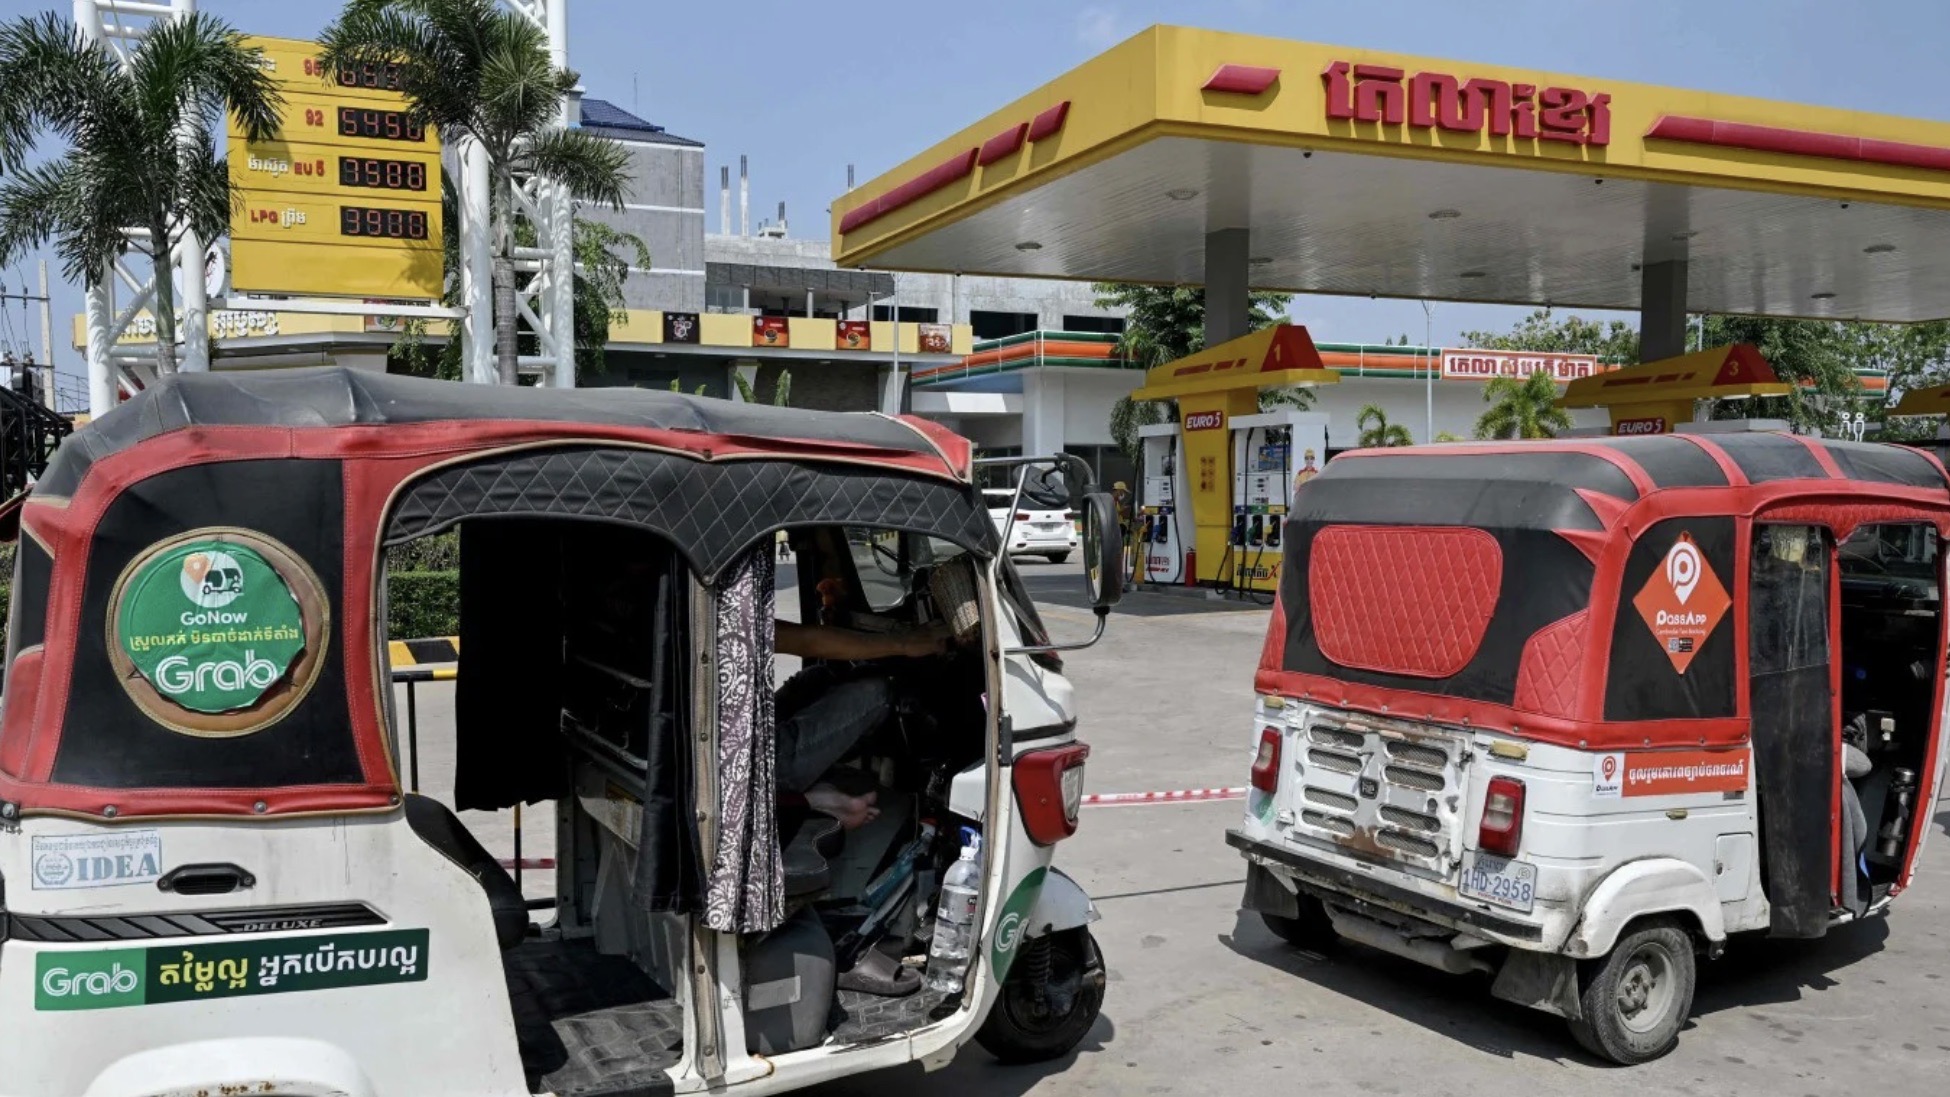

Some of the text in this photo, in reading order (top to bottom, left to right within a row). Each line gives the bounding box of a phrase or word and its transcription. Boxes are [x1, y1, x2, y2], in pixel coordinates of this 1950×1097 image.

[305, 108, 324, 127] 92
[294, 161, 313, 176] EU
[315, 159, 325, 177] 5
[345, 158, 423, 189] 7500
[250, 209, 278, 224] LPG
[346, 208, 424, 238] 3900
[1273, 343, 1282, 361] 1
[1728, 361, 1739, 376] 3
[180, 611, 248, 625] GoNow
[155, 649, 278, 694] Grab
[75, 852, 158, 881] IDEA
[1463, 868, 1531, 901] 1HD-2958
[244, 919, 323, 931] DELUXE
[995, 912, 1029, 953] Gr
[42, 963, 138, 997] Grab
